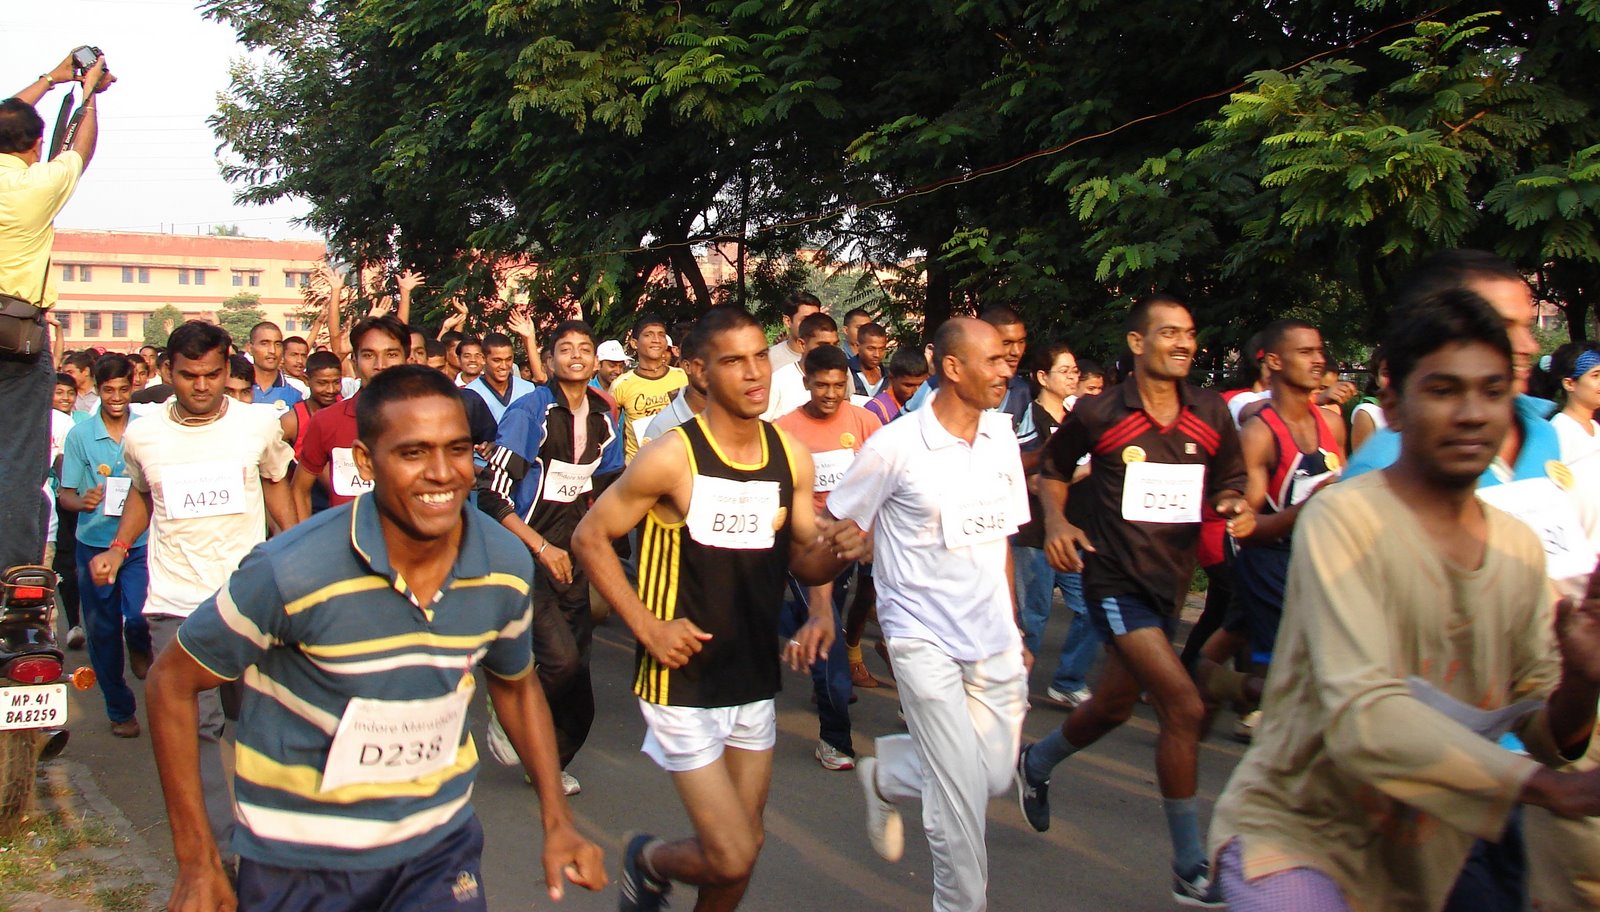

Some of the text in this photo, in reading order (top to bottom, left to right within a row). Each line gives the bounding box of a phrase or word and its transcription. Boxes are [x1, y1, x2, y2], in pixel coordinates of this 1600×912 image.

[634, 392, 670, 412] Coast
[350, 475, 373, 489] A4
[183, 489, 230, 508] A429
[1143, 492, 1188, 510] D242
[712, 513, 759, 534] B203
[962, 511, 1005, 535] C846
[353, 720, 398, 735] Indore
[359, 734, 443, 767] D238
